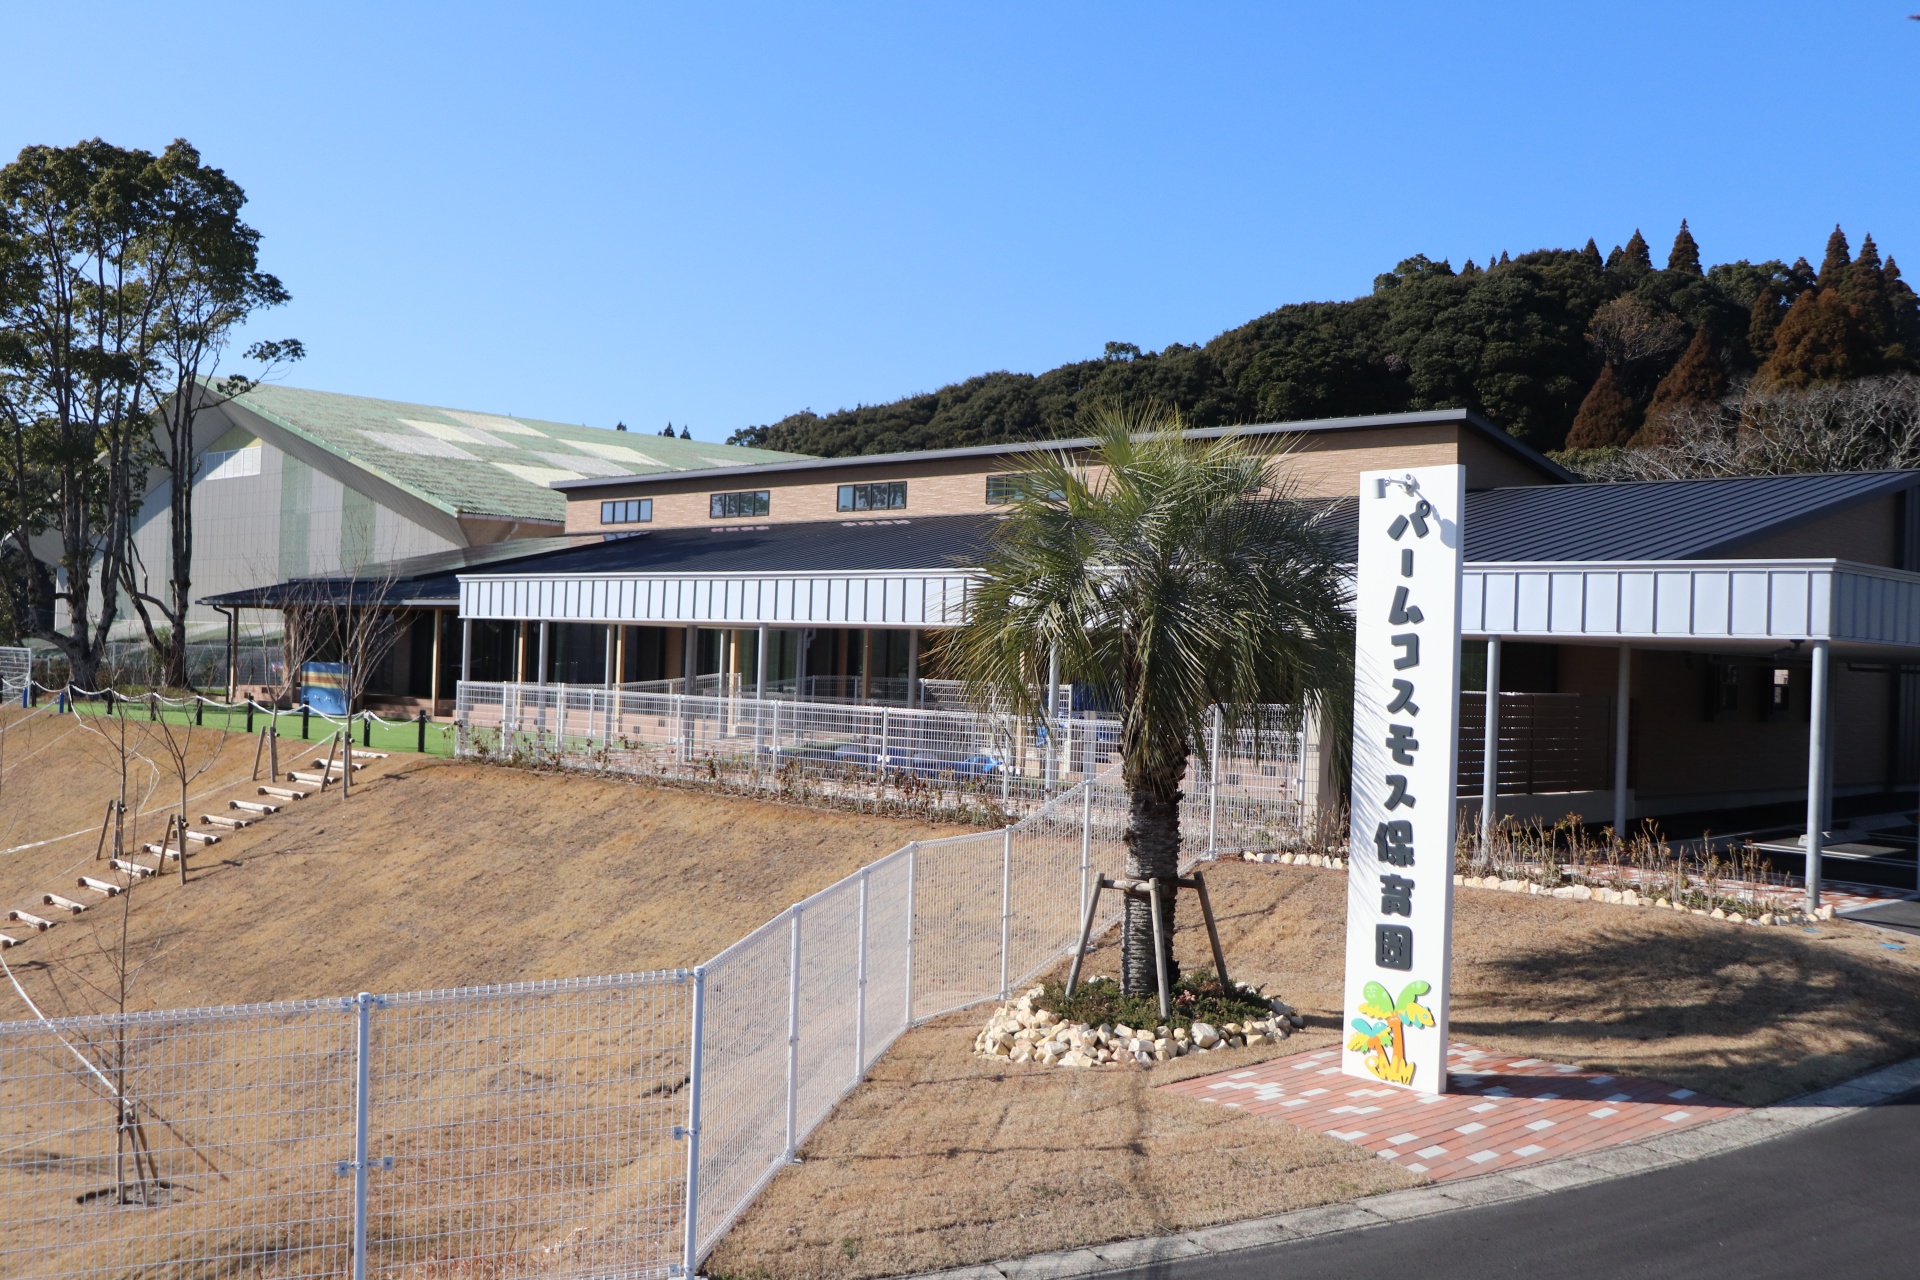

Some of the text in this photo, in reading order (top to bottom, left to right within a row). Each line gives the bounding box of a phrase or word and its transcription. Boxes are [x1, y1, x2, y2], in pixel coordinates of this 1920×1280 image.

[1374, 500, 1430, 971] パームコスモス保育園
